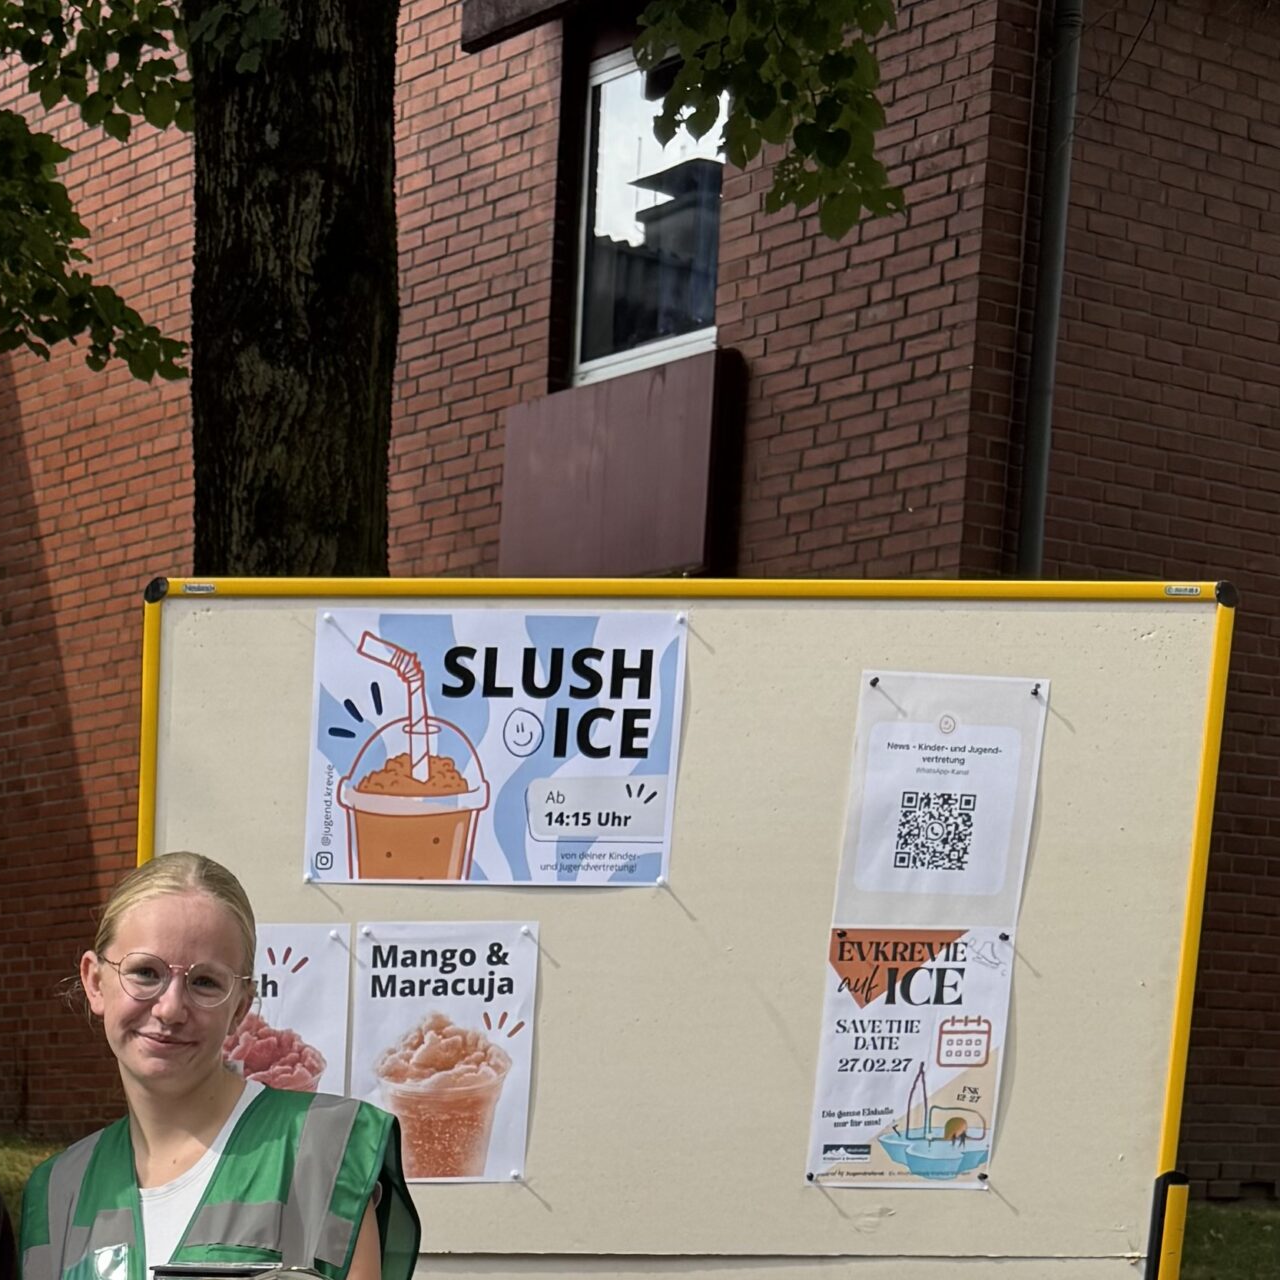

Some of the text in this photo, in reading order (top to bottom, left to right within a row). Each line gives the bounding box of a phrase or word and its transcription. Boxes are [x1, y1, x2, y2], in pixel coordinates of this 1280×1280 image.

[441, 646, 654, 700] SLUSH
[553, 707, 652, 759] ICE
[887, 742, 910, 751] News
[918, 743, 948, 752] Kinder-
[968, 745, 1002, 755] Jugend-
[922, 756, 965, 765] vertretung
[545, 790, 566, 804] Ab
[321, 763, 335, 847] @jugend.krevie
[544, 811, 632, 827] 14:15 Uhr
[579, 851, 606, 860] deiner
[540, 863, 557, 871] und
[371, 942, 510, 974] Mango &
[838, 941, 968, 962] EVKREVIE
[370, 969, 514, 1002] Maracuja
[837, 965, 965, 1006] auf ICE
[836, 1019, 921, 1034] SAVE THE
[854, 1036, 900, 1050] DATE
[837, 1058, 913, 1072] 27.02.27
